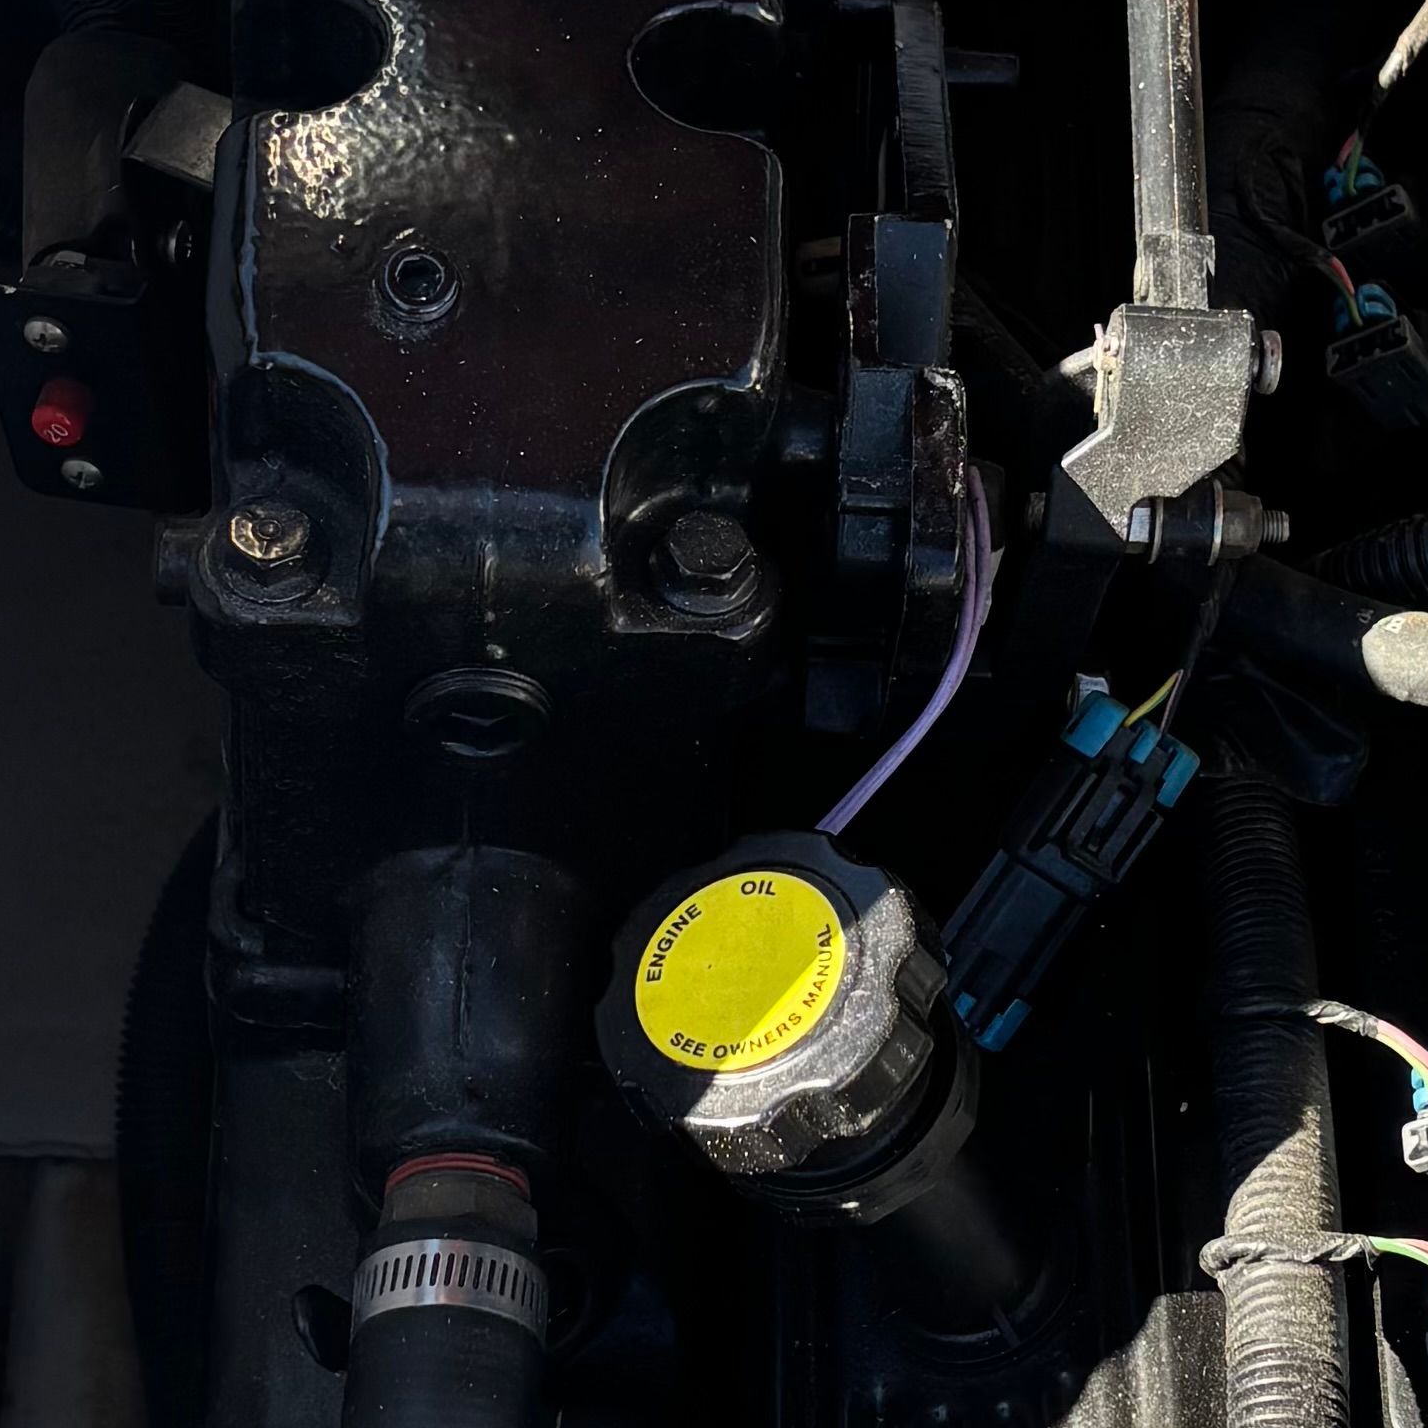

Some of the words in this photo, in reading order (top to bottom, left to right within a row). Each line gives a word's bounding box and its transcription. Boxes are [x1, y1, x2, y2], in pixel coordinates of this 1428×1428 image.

[646, 902, 702, 983] ENGINE
[740, 879, 777, 897] OIL
[669, 1031, 708, 1058] SEE
[712, 1012, 802, 1060] OWNERS
[802, 923, 834, 1009] MANUAL
